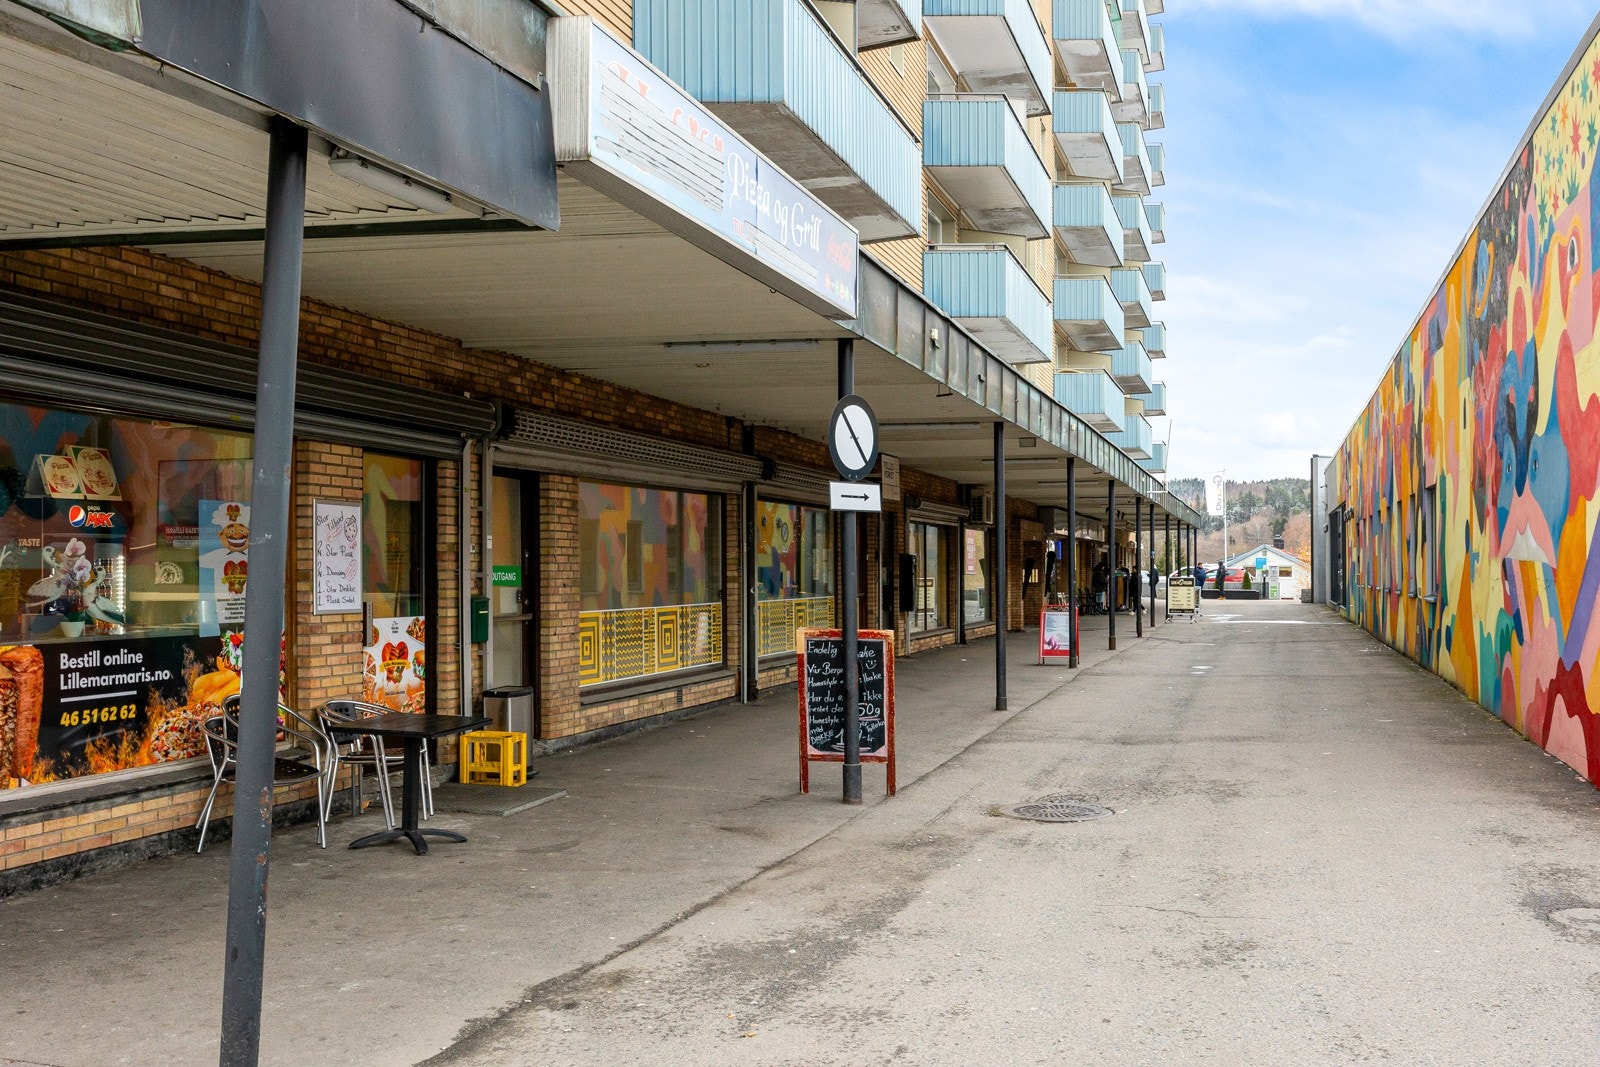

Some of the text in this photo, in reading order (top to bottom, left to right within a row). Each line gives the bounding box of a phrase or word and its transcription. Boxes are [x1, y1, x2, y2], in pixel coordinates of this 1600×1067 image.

[727, 152, 770, 217] Pizza
[774, 199, 788, 246] og
[791, 202, 822, 252] Grill
[85, 512, 116, 528] MAX
[18, 538, 41, 547] TASTE
[60, 648, 143, 670] Bestill online
[807, 641, 838, 658] Endelig
[60, 667, 170, 691] Lillemarmaris.no
[807, 692, 823, 703] Har
[824, 691, 835, 703] du
[862, 691, 882, 701] ikke
[60, 704, 137, 728] 46 51 62 62
